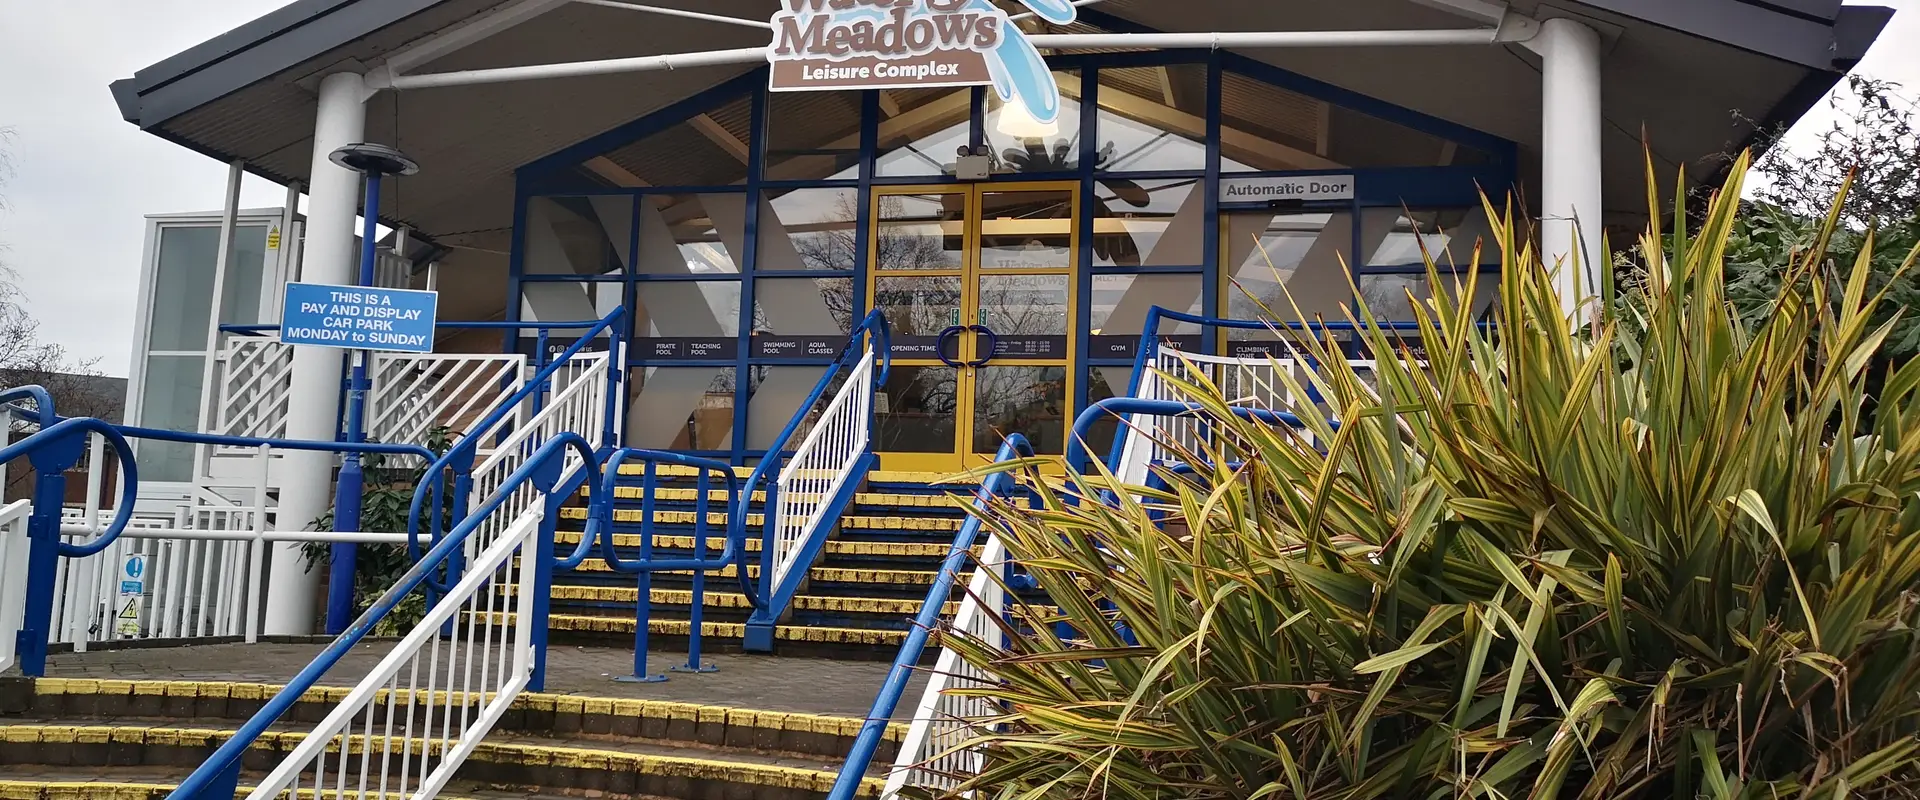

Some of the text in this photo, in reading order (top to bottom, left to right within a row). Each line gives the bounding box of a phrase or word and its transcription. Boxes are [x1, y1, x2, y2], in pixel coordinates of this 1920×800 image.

[774, 7, 997, 55] Meadows
[802, 61, 959, 84] Leisure Complex
[1226, 182, 1347, 196] Automatic Door
[330, 292, 391, 306] THIS IS A
[301, 303, 422, 321] PAY AND DISPLAY
[323, 317, 394, 331] CAR PARK
[287, 327, 426, 346] MONDAY to SUNDAY
